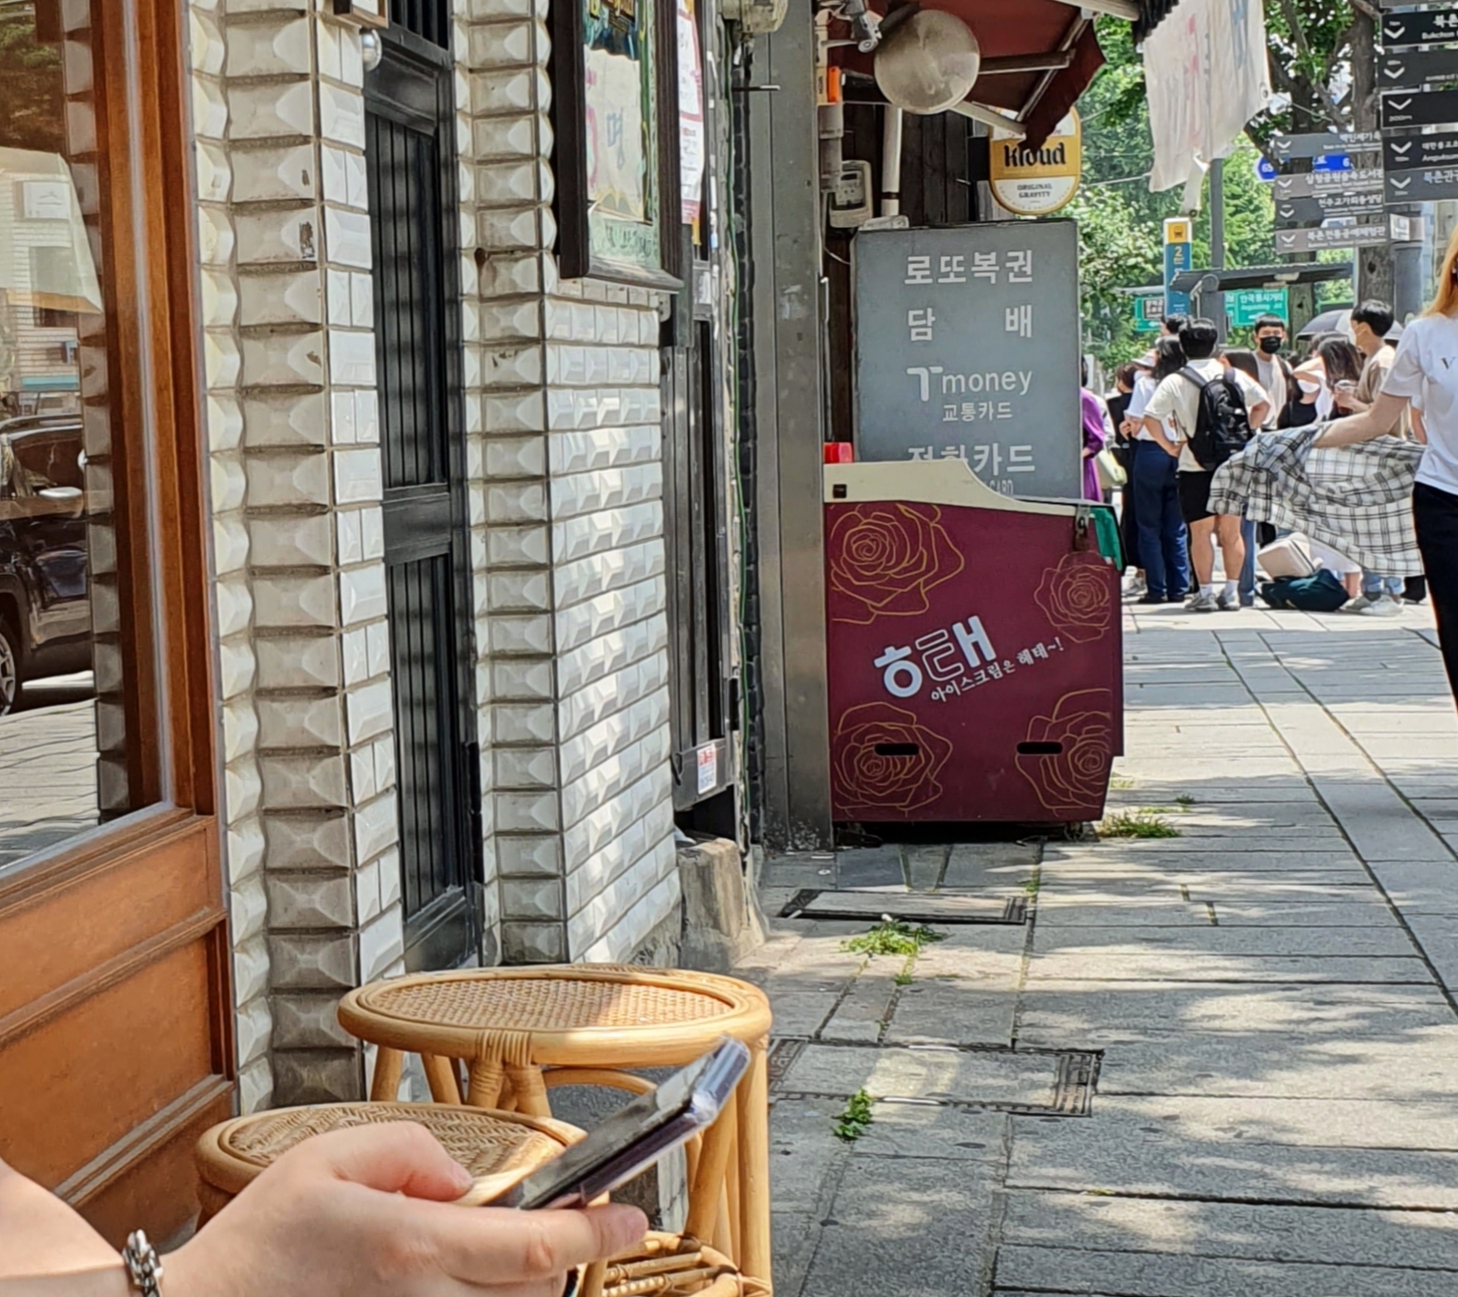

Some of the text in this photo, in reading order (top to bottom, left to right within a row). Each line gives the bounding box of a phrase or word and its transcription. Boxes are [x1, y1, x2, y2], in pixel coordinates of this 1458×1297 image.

[904, 250, 1033, 285] 로또복권
[908, 304, 1032, 341] 담 배
[906, 366, 1032, 402] Tmoney
[943, 401, 1013, 422] 교통카드
[930, 659, 1016, 703] 아이스크림은
